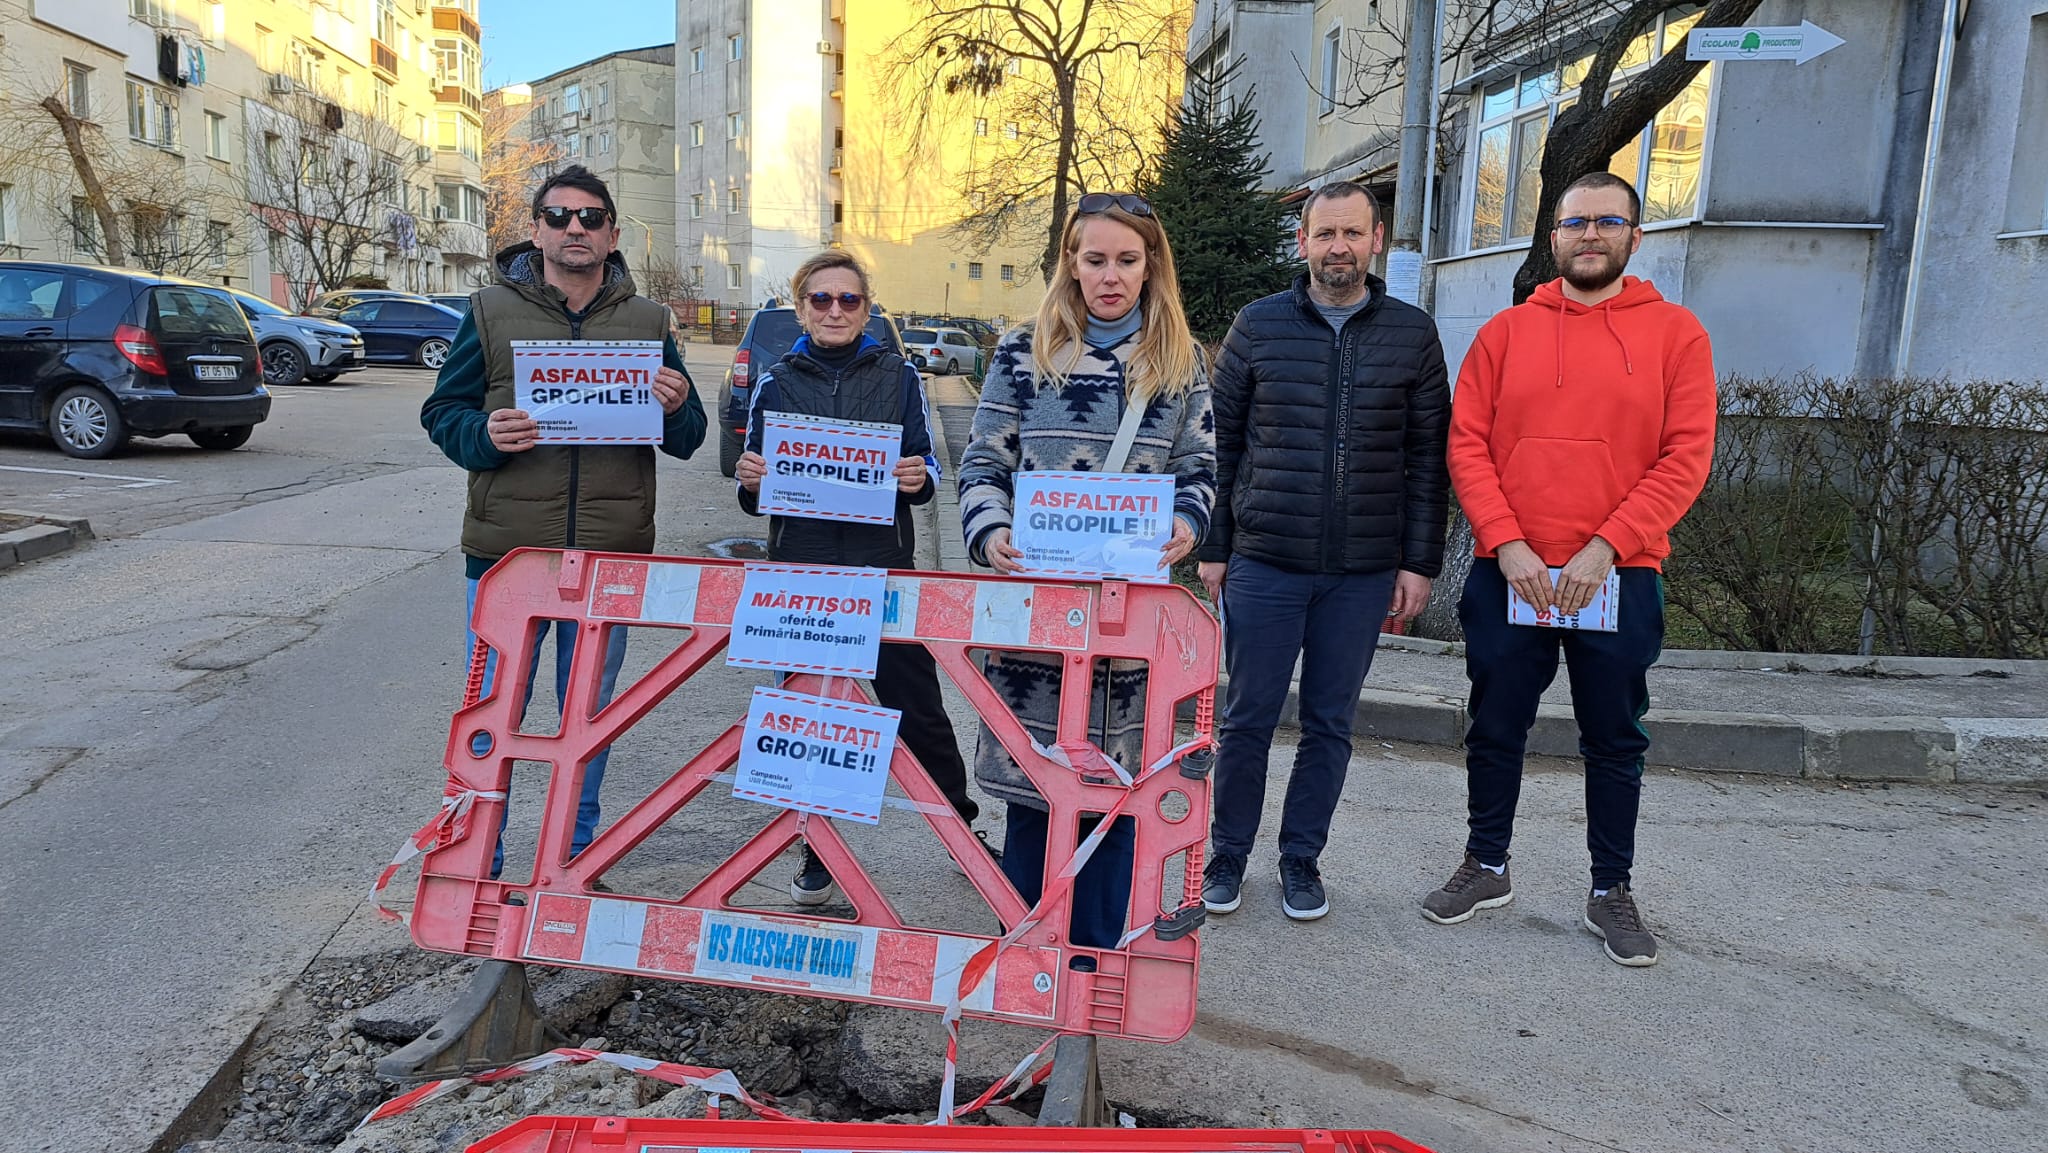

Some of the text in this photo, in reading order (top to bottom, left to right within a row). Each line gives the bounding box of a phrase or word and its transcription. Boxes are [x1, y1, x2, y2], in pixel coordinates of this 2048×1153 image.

[1702, 38, 1801, 48] ECOLAND PRODUCTION
[200, 366, 210, 377] BT
[530, 368, 649, 388] ASFALTAȚI
[531, 388, 633, 405] GROPILE
[536, 418, 567, 426] ampanie
[1337, 387, 1349, 440] PARAGOOSE
[776, 440, 887, 469] ASFALTAȚI
[775, 460, 869, 484] GROPILE
[1335, 449, 1345, 503] PARAGOOSE
[1030, 490, 1158, 517] ASFALTAȚI
[1029, 512, 1138, 536] GROPILE
[751, 589, 872, 617] MĂRȚIȘOR
[779, 613, 835, 629] oferit de
[744, 625, 866, 646] Primăria Botoșani!
[760, 712, 881, 752] ASFALTAȚI
[757, 735, 859, 770] GROPILE
[750, 769, 783, 781] Campanie
[708, 923, 857, 979] NOVA APASERV SA
